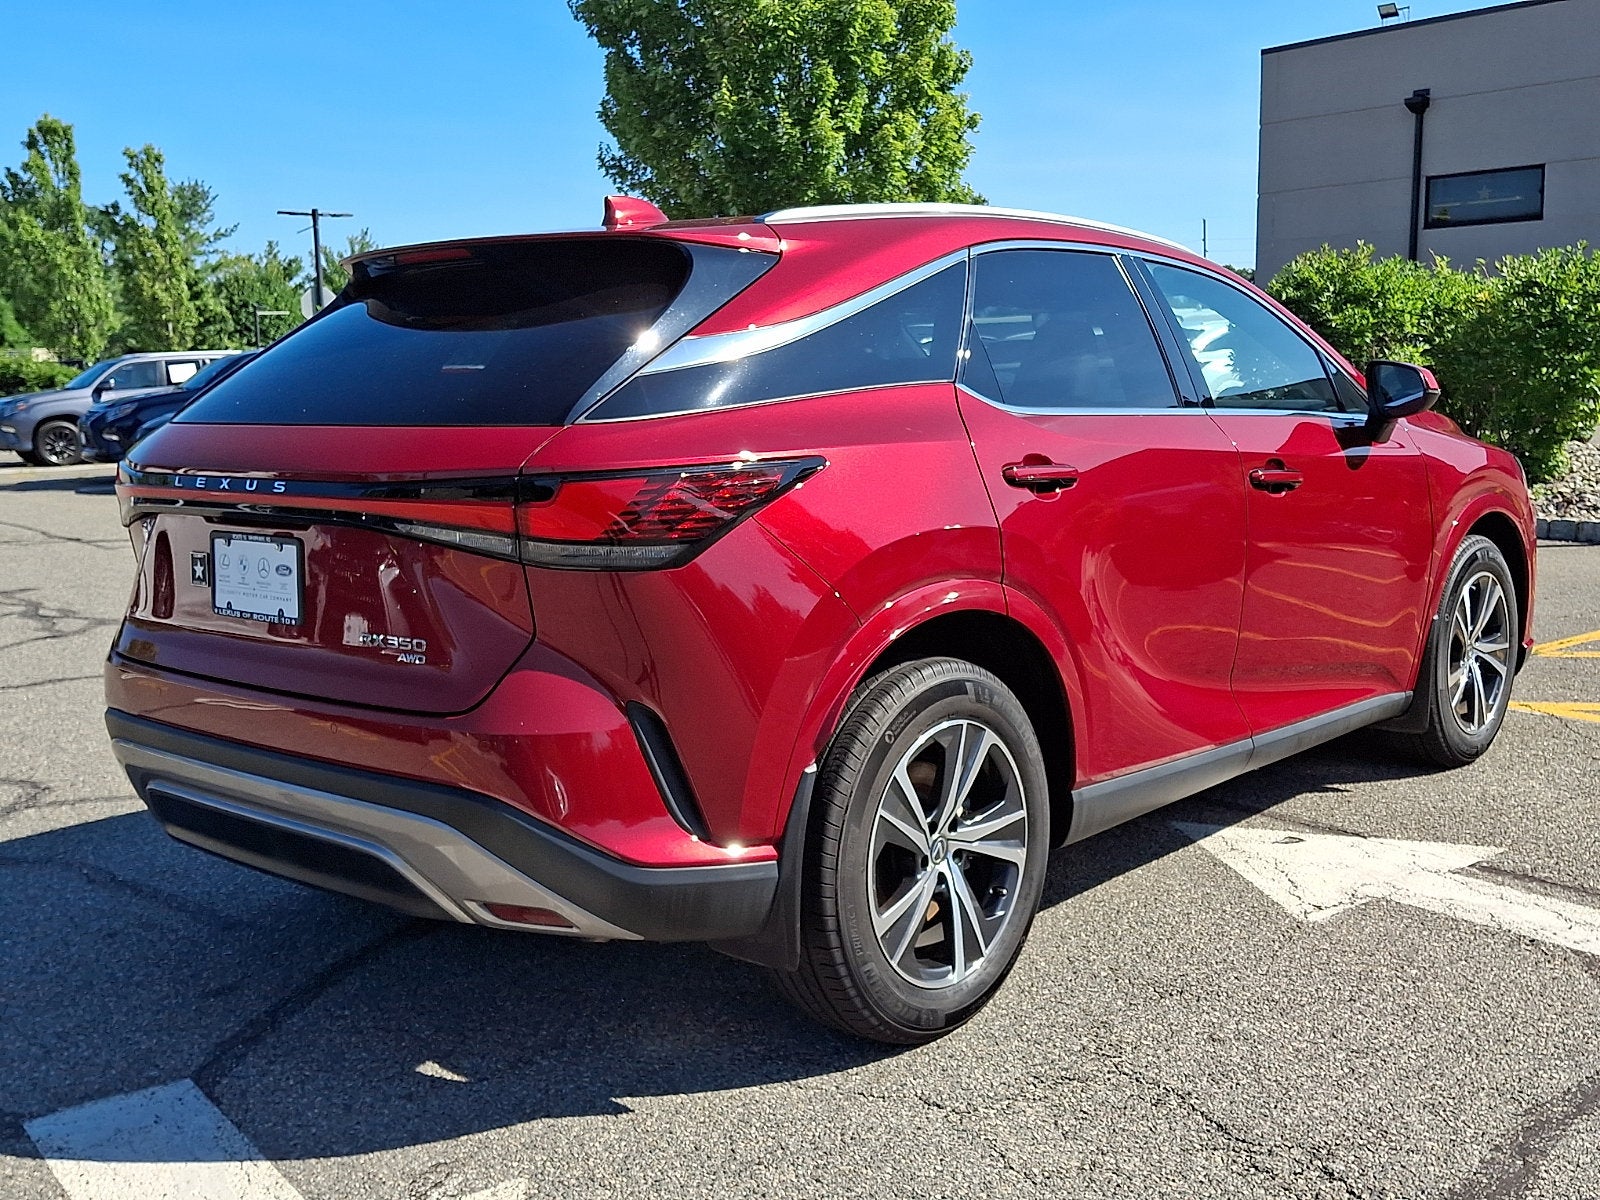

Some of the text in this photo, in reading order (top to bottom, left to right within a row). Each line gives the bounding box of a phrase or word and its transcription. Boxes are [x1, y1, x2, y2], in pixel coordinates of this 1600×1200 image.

[174, 475, 287, 493] LEXUS
[219, 608, 241, 617] LEXUS
[253, 613, 279, 624] ROUTE
[281, 617, 290, 625] 10
[359, 632, 427, 652] RX350
[397, 653, 426, 665] AWD
[847, 902, 864, 956] PRIMACY
